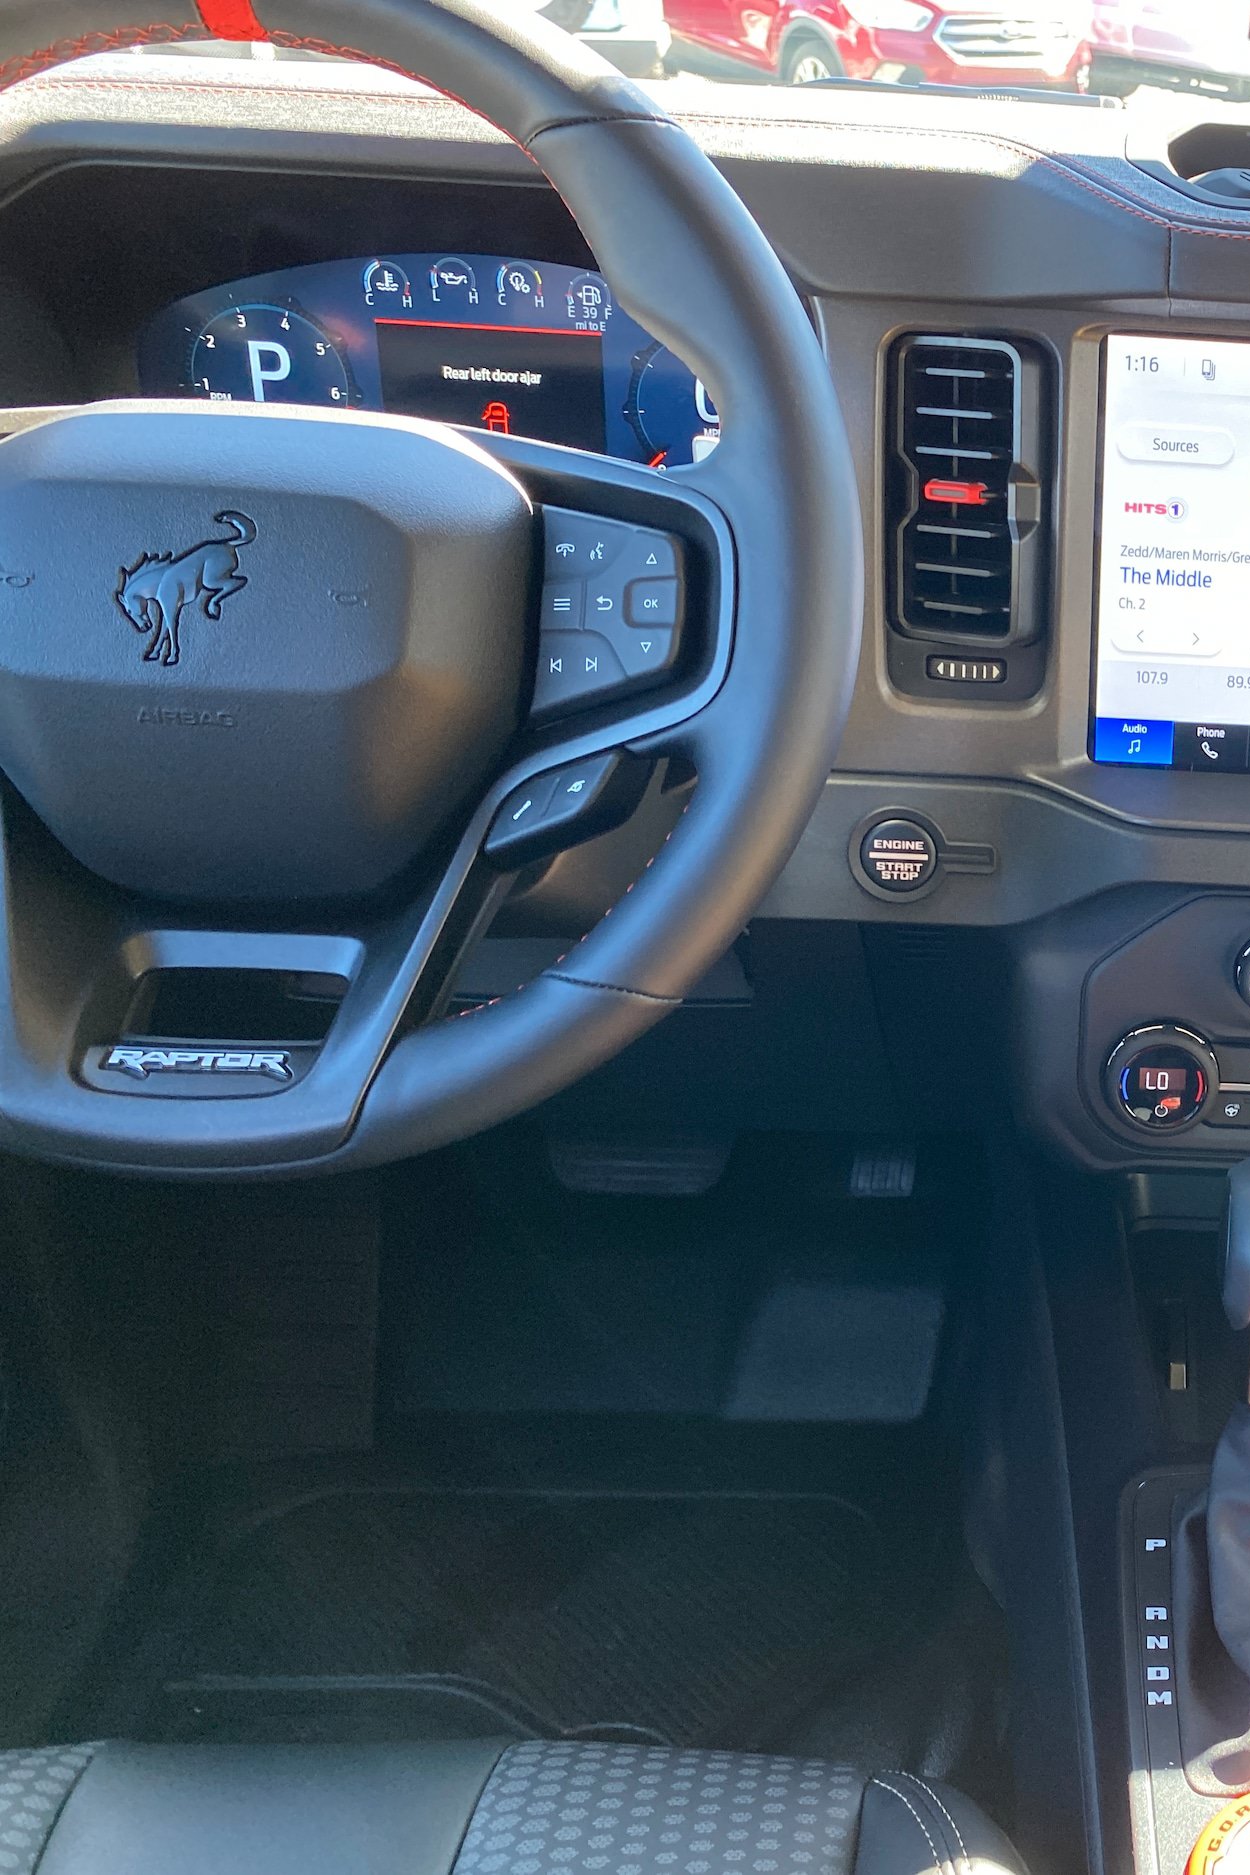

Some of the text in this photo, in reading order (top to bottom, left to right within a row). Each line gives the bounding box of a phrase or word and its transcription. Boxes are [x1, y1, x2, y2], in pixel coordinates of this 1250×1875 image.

[364, 293, 374, 306] C
[402, 295, 413, 309] H
[432, 289, 441, 302] L
[469, 291, 479, 304] H
[498, 293, 507, 307] C
[534, 295, 545, 308] H
[567, 305, 576, 318] E
[583, 306, 598, 319] 39
[236, 315, 247, 328] 3
[280, 318, 290, 331] 4
[589, 321, 599, 332] to
[600, 322, 606, 332] E
[206, 335, 215, 348] 2
[316, 342, 326, 356] 5
[1125, 355, 1159, 373] 1:16
[248, 340, 291, 402] P
[443, 366, 542, 386] Rear left door ajar
[202, 377, 209, 390] 1
[210, 392, 232, 400] RPM
[331, 387, 341, 400] 6
[1152, 438, 1199, 454] Sources
[1120, 545, 1190, 561] Zedd/Maren
[1120, 567, 1213, 588] The Middle
[643, 599, 659, 609] OK
[1118, 597, 1146, 610] Ch. 2
[1136, 671, 1169, 685] 107.9
[136, 705, 236, 728] AIRBAG
[1122, 723, 1148, 735] Audio
[1197, 726, 1226, 739] Phone
[873, 839, 925, 851] ENGINE
[875, 861, 923, 872] START
[881, 870, 919, 881] STOP
[107, 1047, 292, 1081] RAPTOR
[1145, 1072, 1169, 1090] LO
[1145, 1538, 1167, 1551] P
[1146, 1635, 1169, 1650] N
[1147, 1666, 1170, 1681] D
[1147, 1690, 1173, 1706] M
